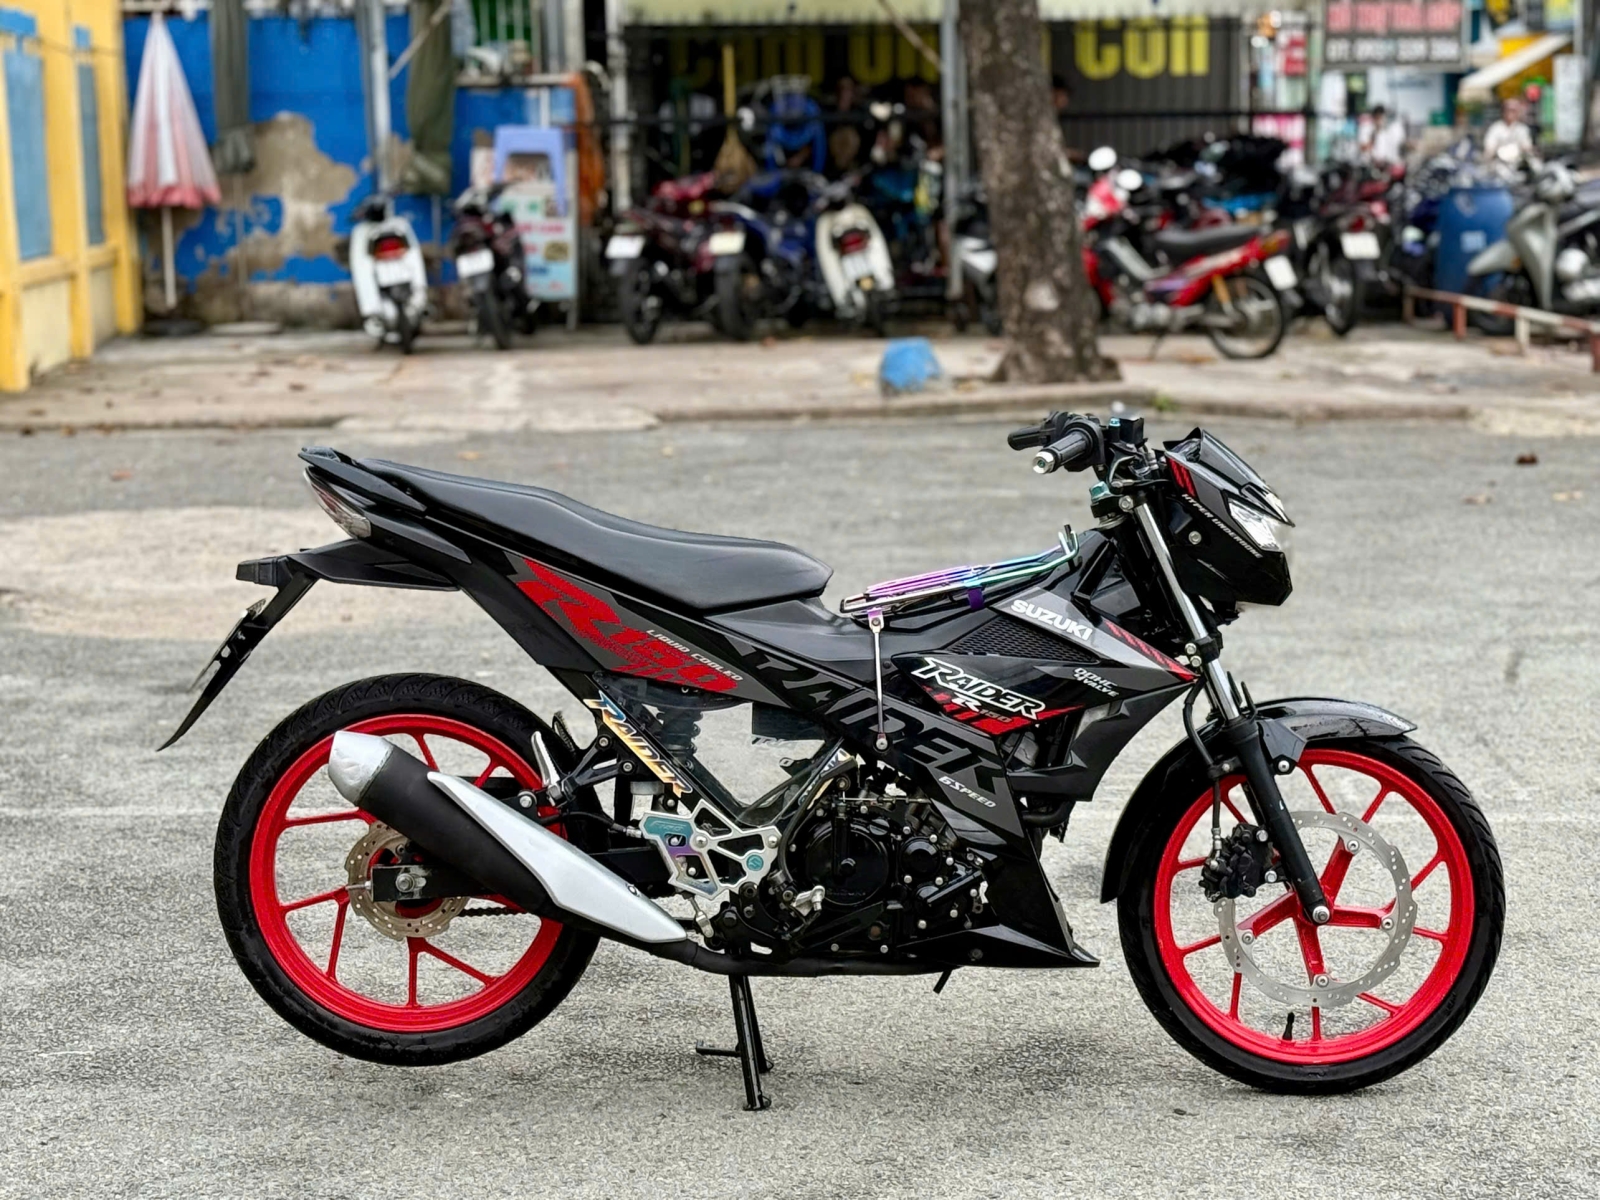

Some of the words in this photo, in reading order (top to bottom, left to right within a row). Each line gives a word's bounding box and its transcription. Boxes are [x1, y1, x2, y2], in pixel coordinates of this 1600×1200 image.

[1181, 493, 1215, 518] HYPER
[1212, 518, 1264, 559] UNDERBONE
[1010, 598, 1093, 641] SUZUKI
[646, 629, 690, 654] LIQUID
[691, 652, 744, 683] COOLED
[911, 656, 1046, 721] RAIDER
[582, 689, 694, 799] RAIDER
